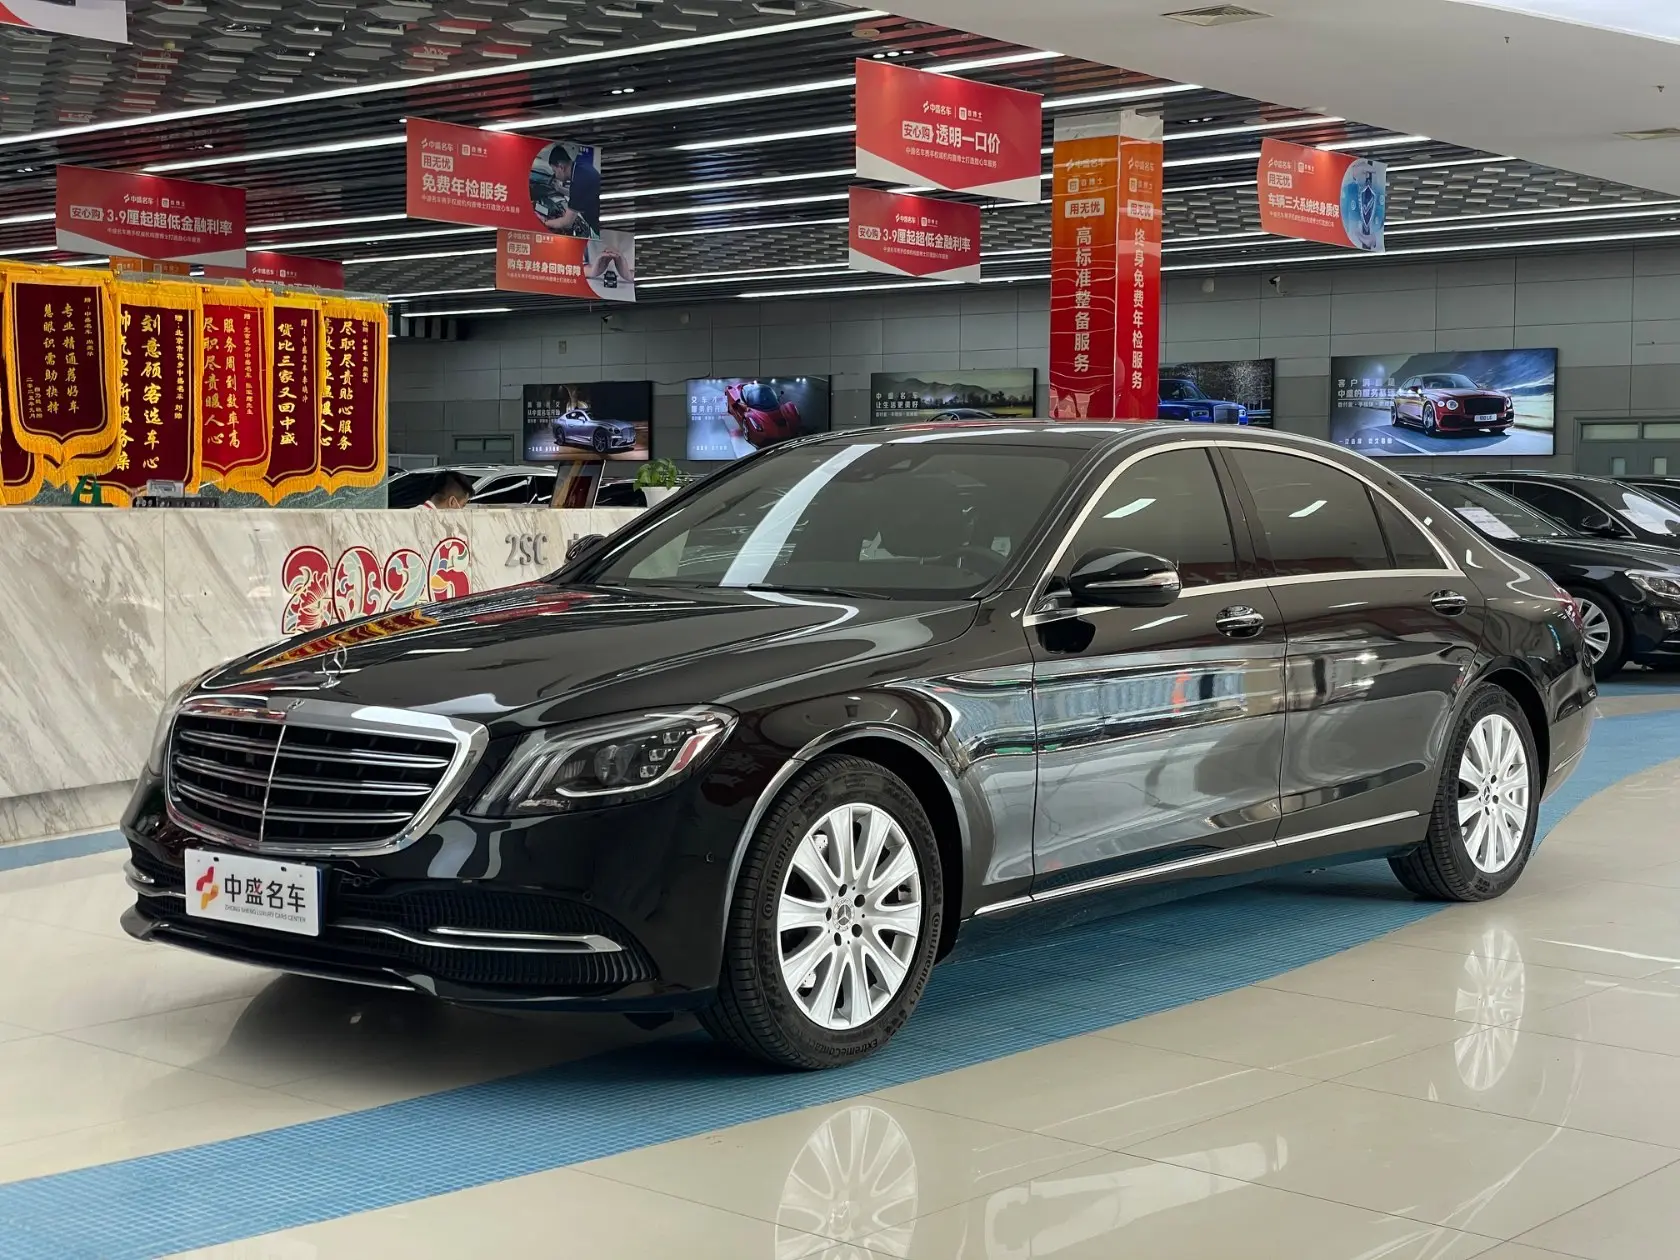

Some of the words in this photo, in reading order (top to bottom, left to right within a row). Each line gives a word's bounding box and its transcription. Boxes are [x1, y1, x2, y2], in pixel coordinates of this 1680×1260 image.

[930, 103, 952, 116] 中盛名车
[903, 123, 931, 140] 安心购
[936, 123, 1000, 155] 透明一口价
[423, 155, 451, 170] 用无忧
[422, 173, 508, 202] 免费年检服务
[1268, 192, 1340, 218] 车辆三大系统终身质保
[107, 209, 233, 236] 3.9厘起超低金融利率
[1069, 201, 1101, 215] 用无忧
[883, 228, 971, 253] 3.9厘起超低金融利率
[507, 258, 581, 277] 购车享终身回购保障
[1073, 226, 1092, 372] 高标准整备服务
[1131, 228, 1145, 389] 终身免费年检服务
[43, 303, 59, 414] 慧眼识需助抉择
[62, 303, 79, 414] 专业精通荐好车
[203, 317, 225, 445] 尽职尽责暖人心
[223, 318, 240, 448] 服务周到效率高
[277, 323, 298, 446] 货比三家又回中盛
[337, 320, 356, 451] 尽职尽责贴心服务
[504, 533, 548, 567] 2SC
[224, 873, 306, 913] 中盛名车
[763, 830, 796, 919] Continental
[288, 914, 306, 923] CENTER
[914, 912, 940, 996] Continental
